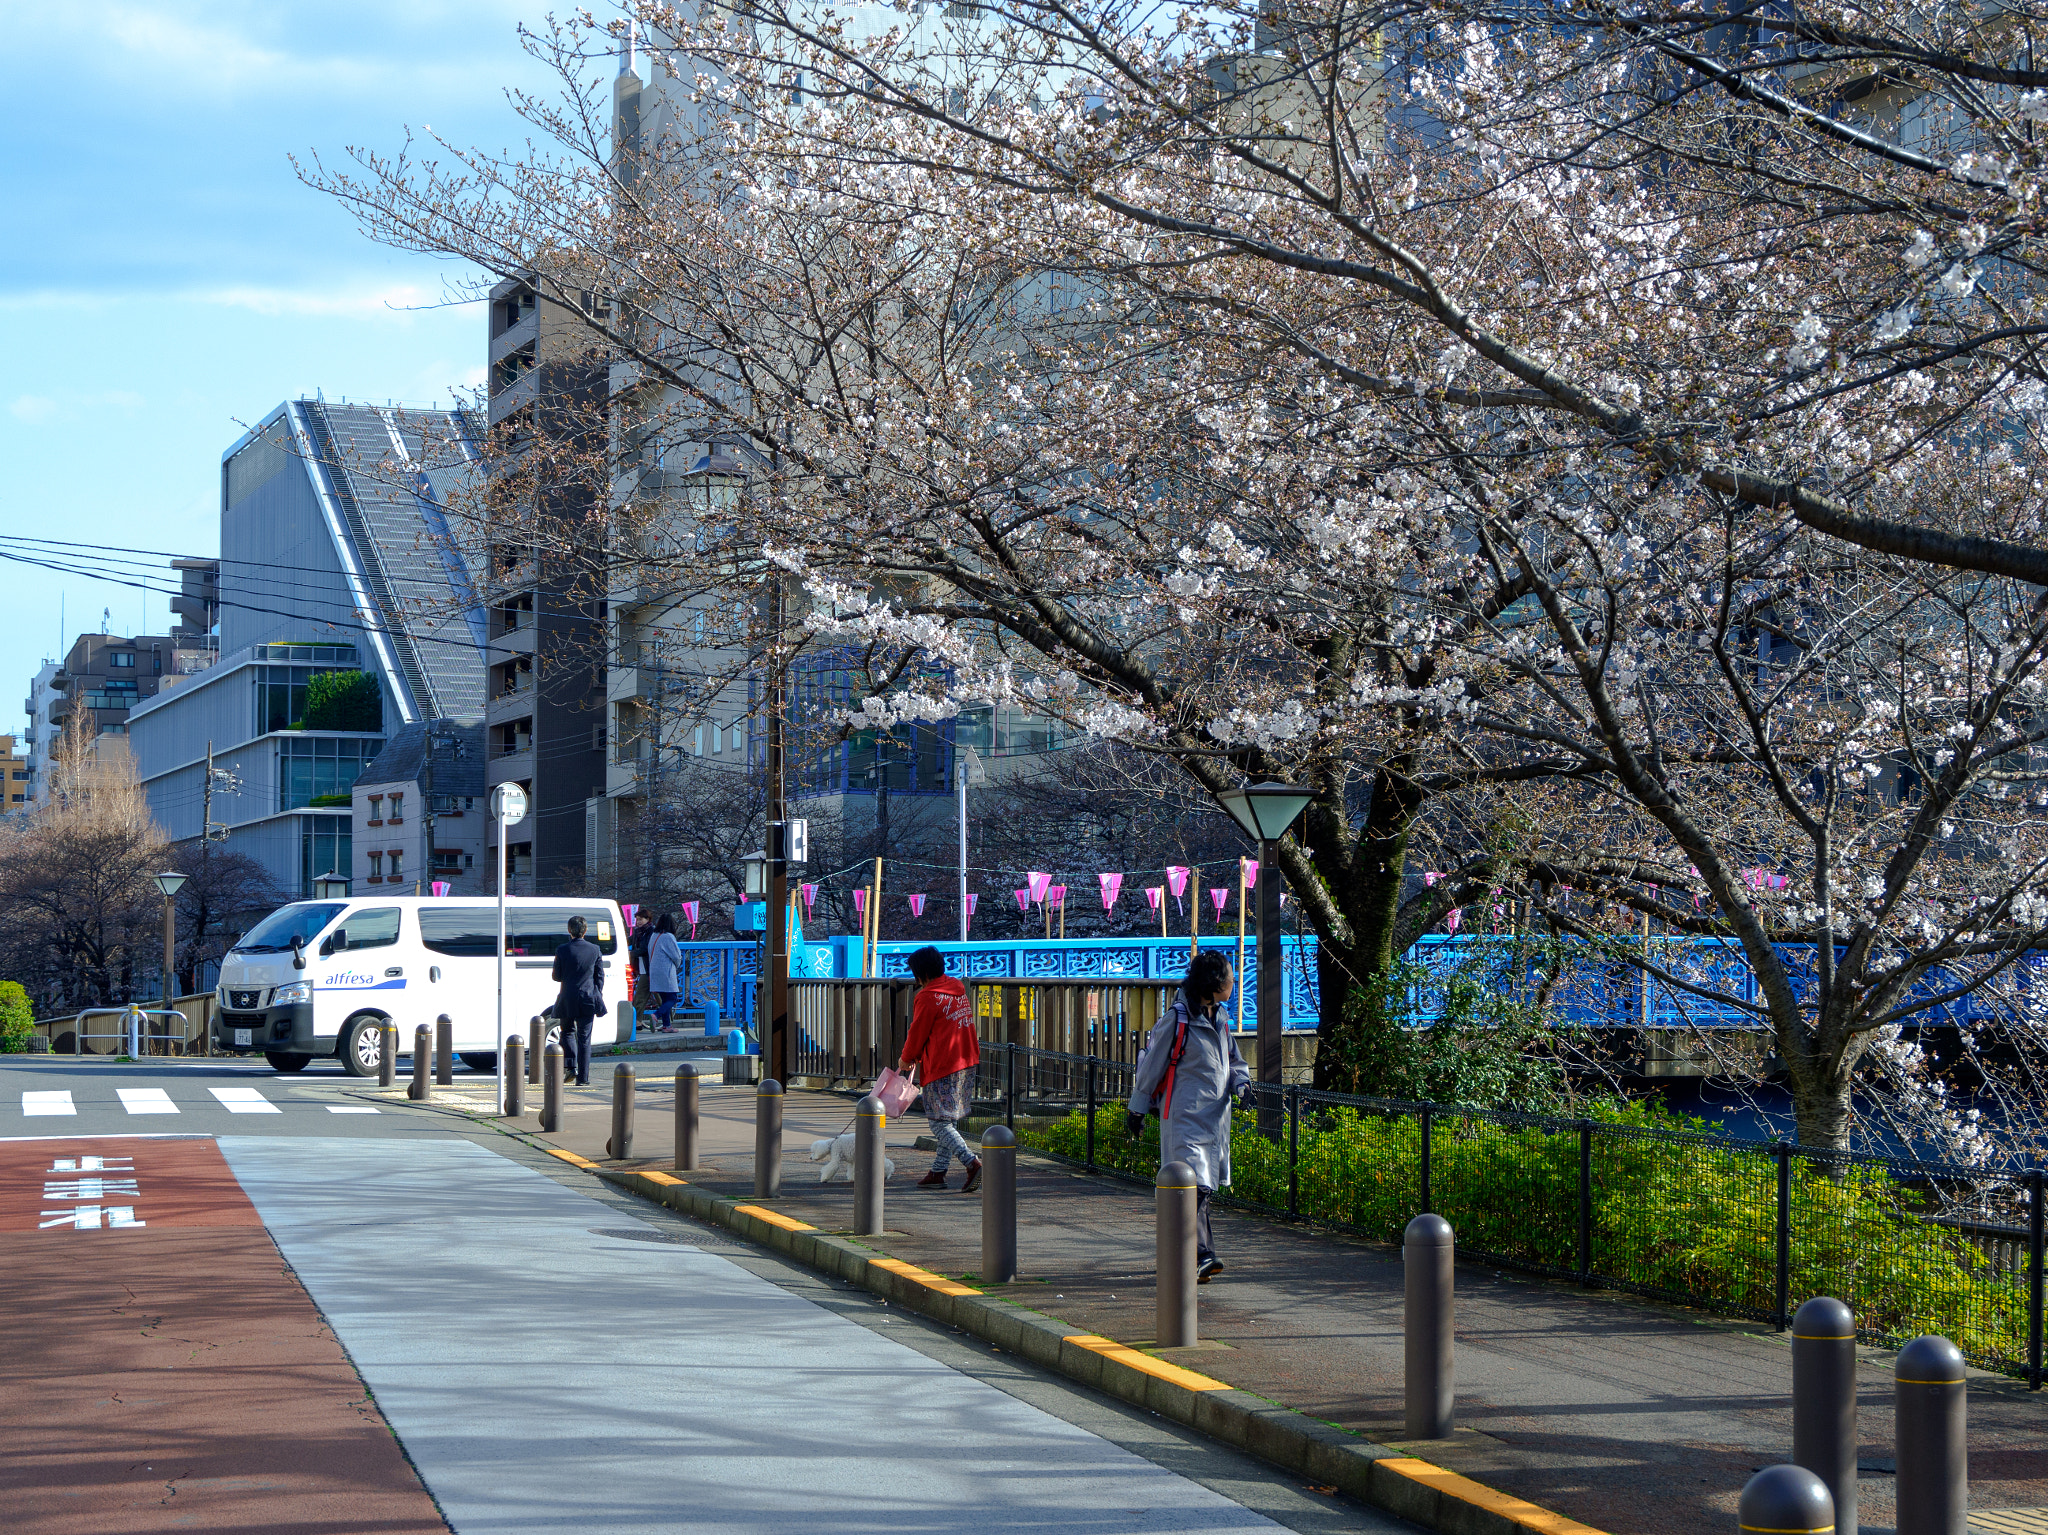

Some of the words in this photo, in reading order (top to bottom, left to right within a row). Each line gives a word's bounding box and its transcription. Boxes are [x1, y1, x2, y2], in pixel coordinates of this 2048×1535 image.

[325, 970, 374, 984] alfresa
[38, 1155, 147, 1229] 止まれ
